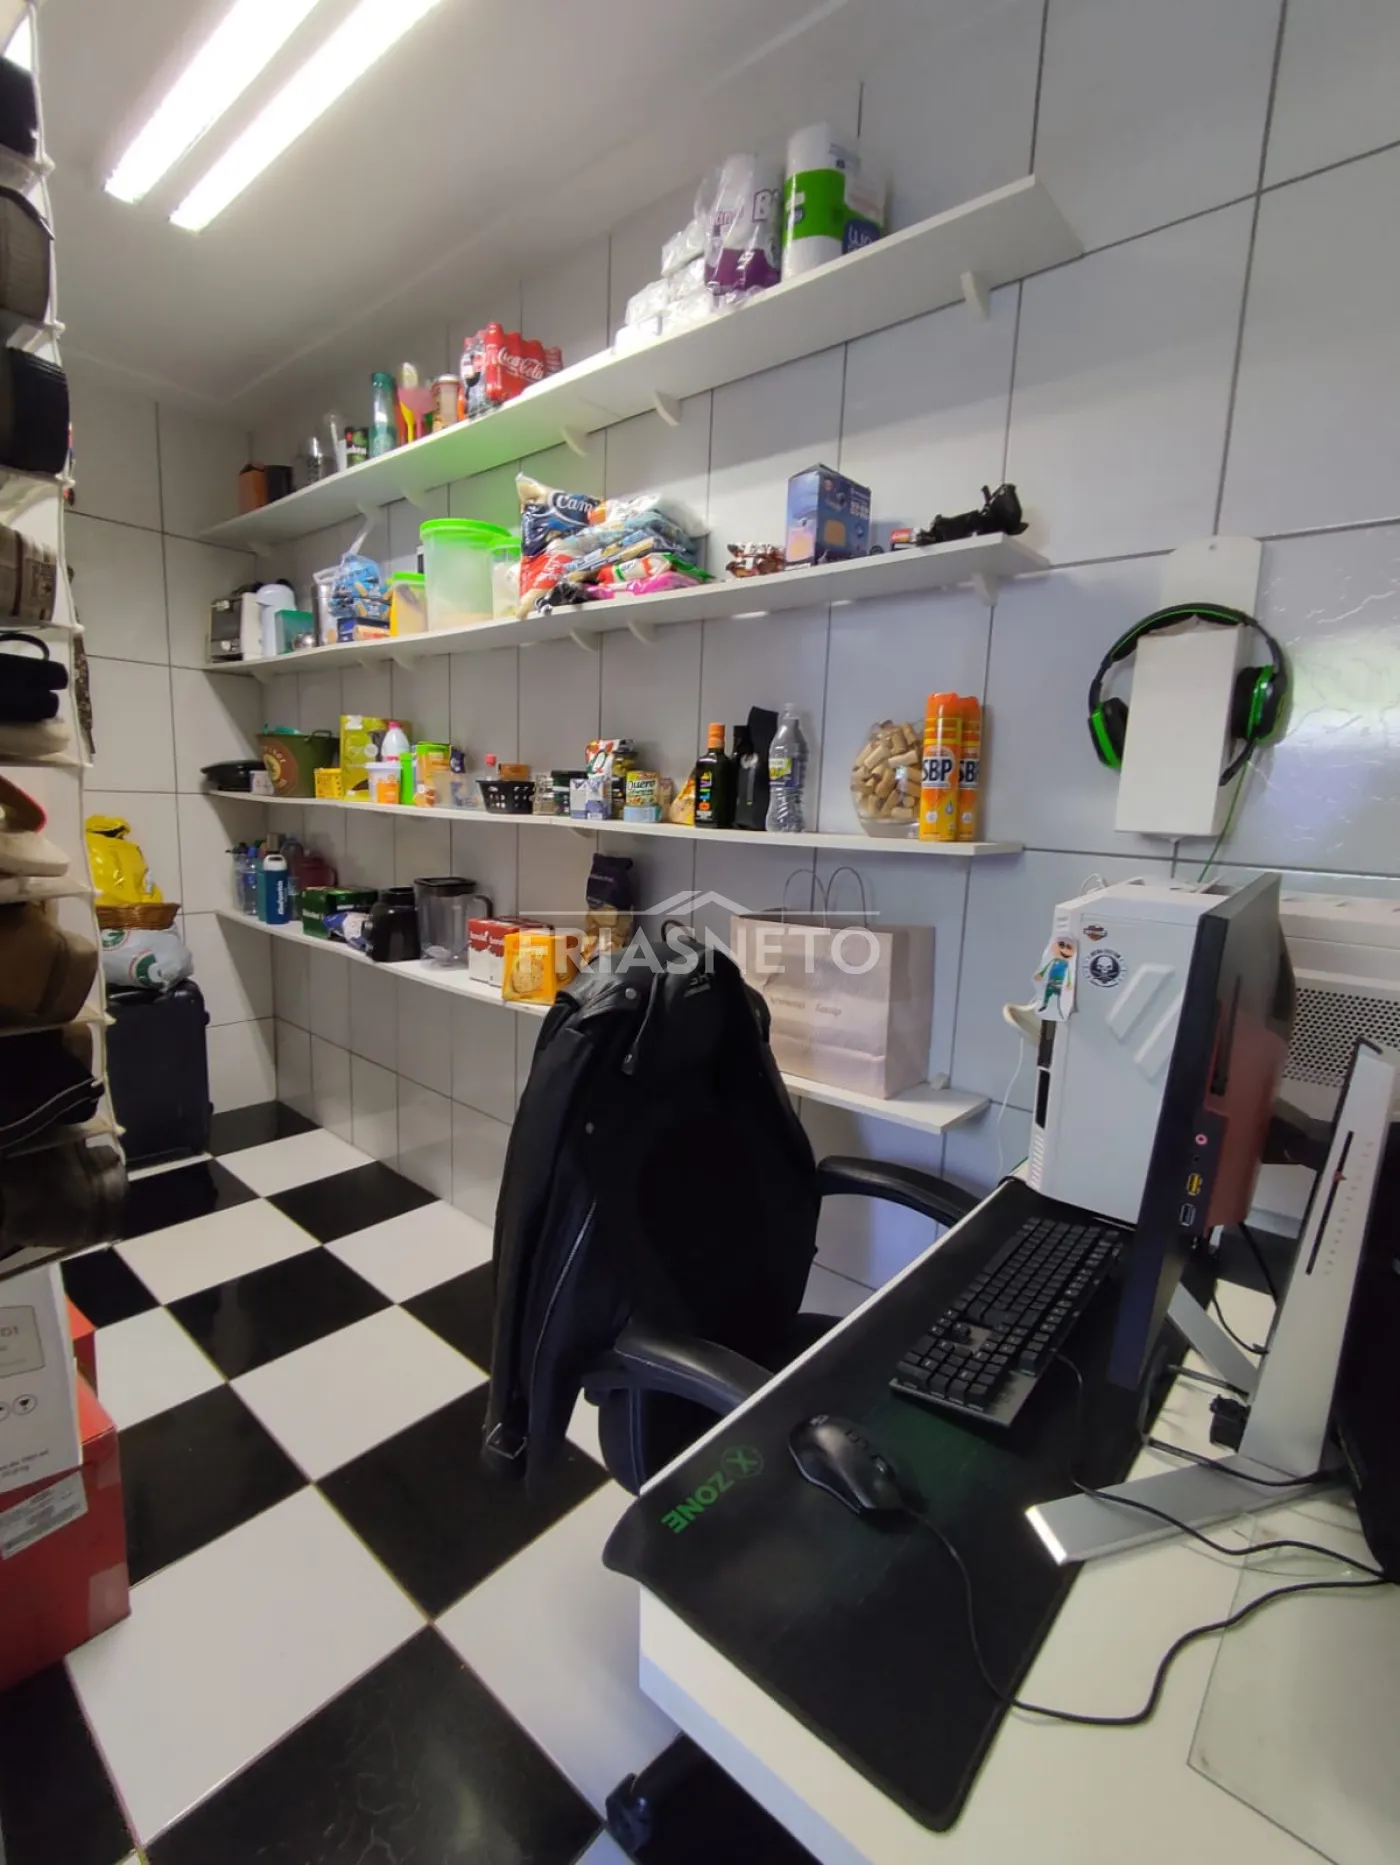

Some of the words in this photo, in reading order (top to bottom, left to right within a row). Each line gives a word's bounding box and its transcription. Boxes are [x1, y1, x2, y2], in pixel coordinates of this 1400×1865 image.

[498, 346, 544, 380] Coca-Cola
[923, 759, 952, 782] SBP
[660, 1470, 735, 1534] ZONE
